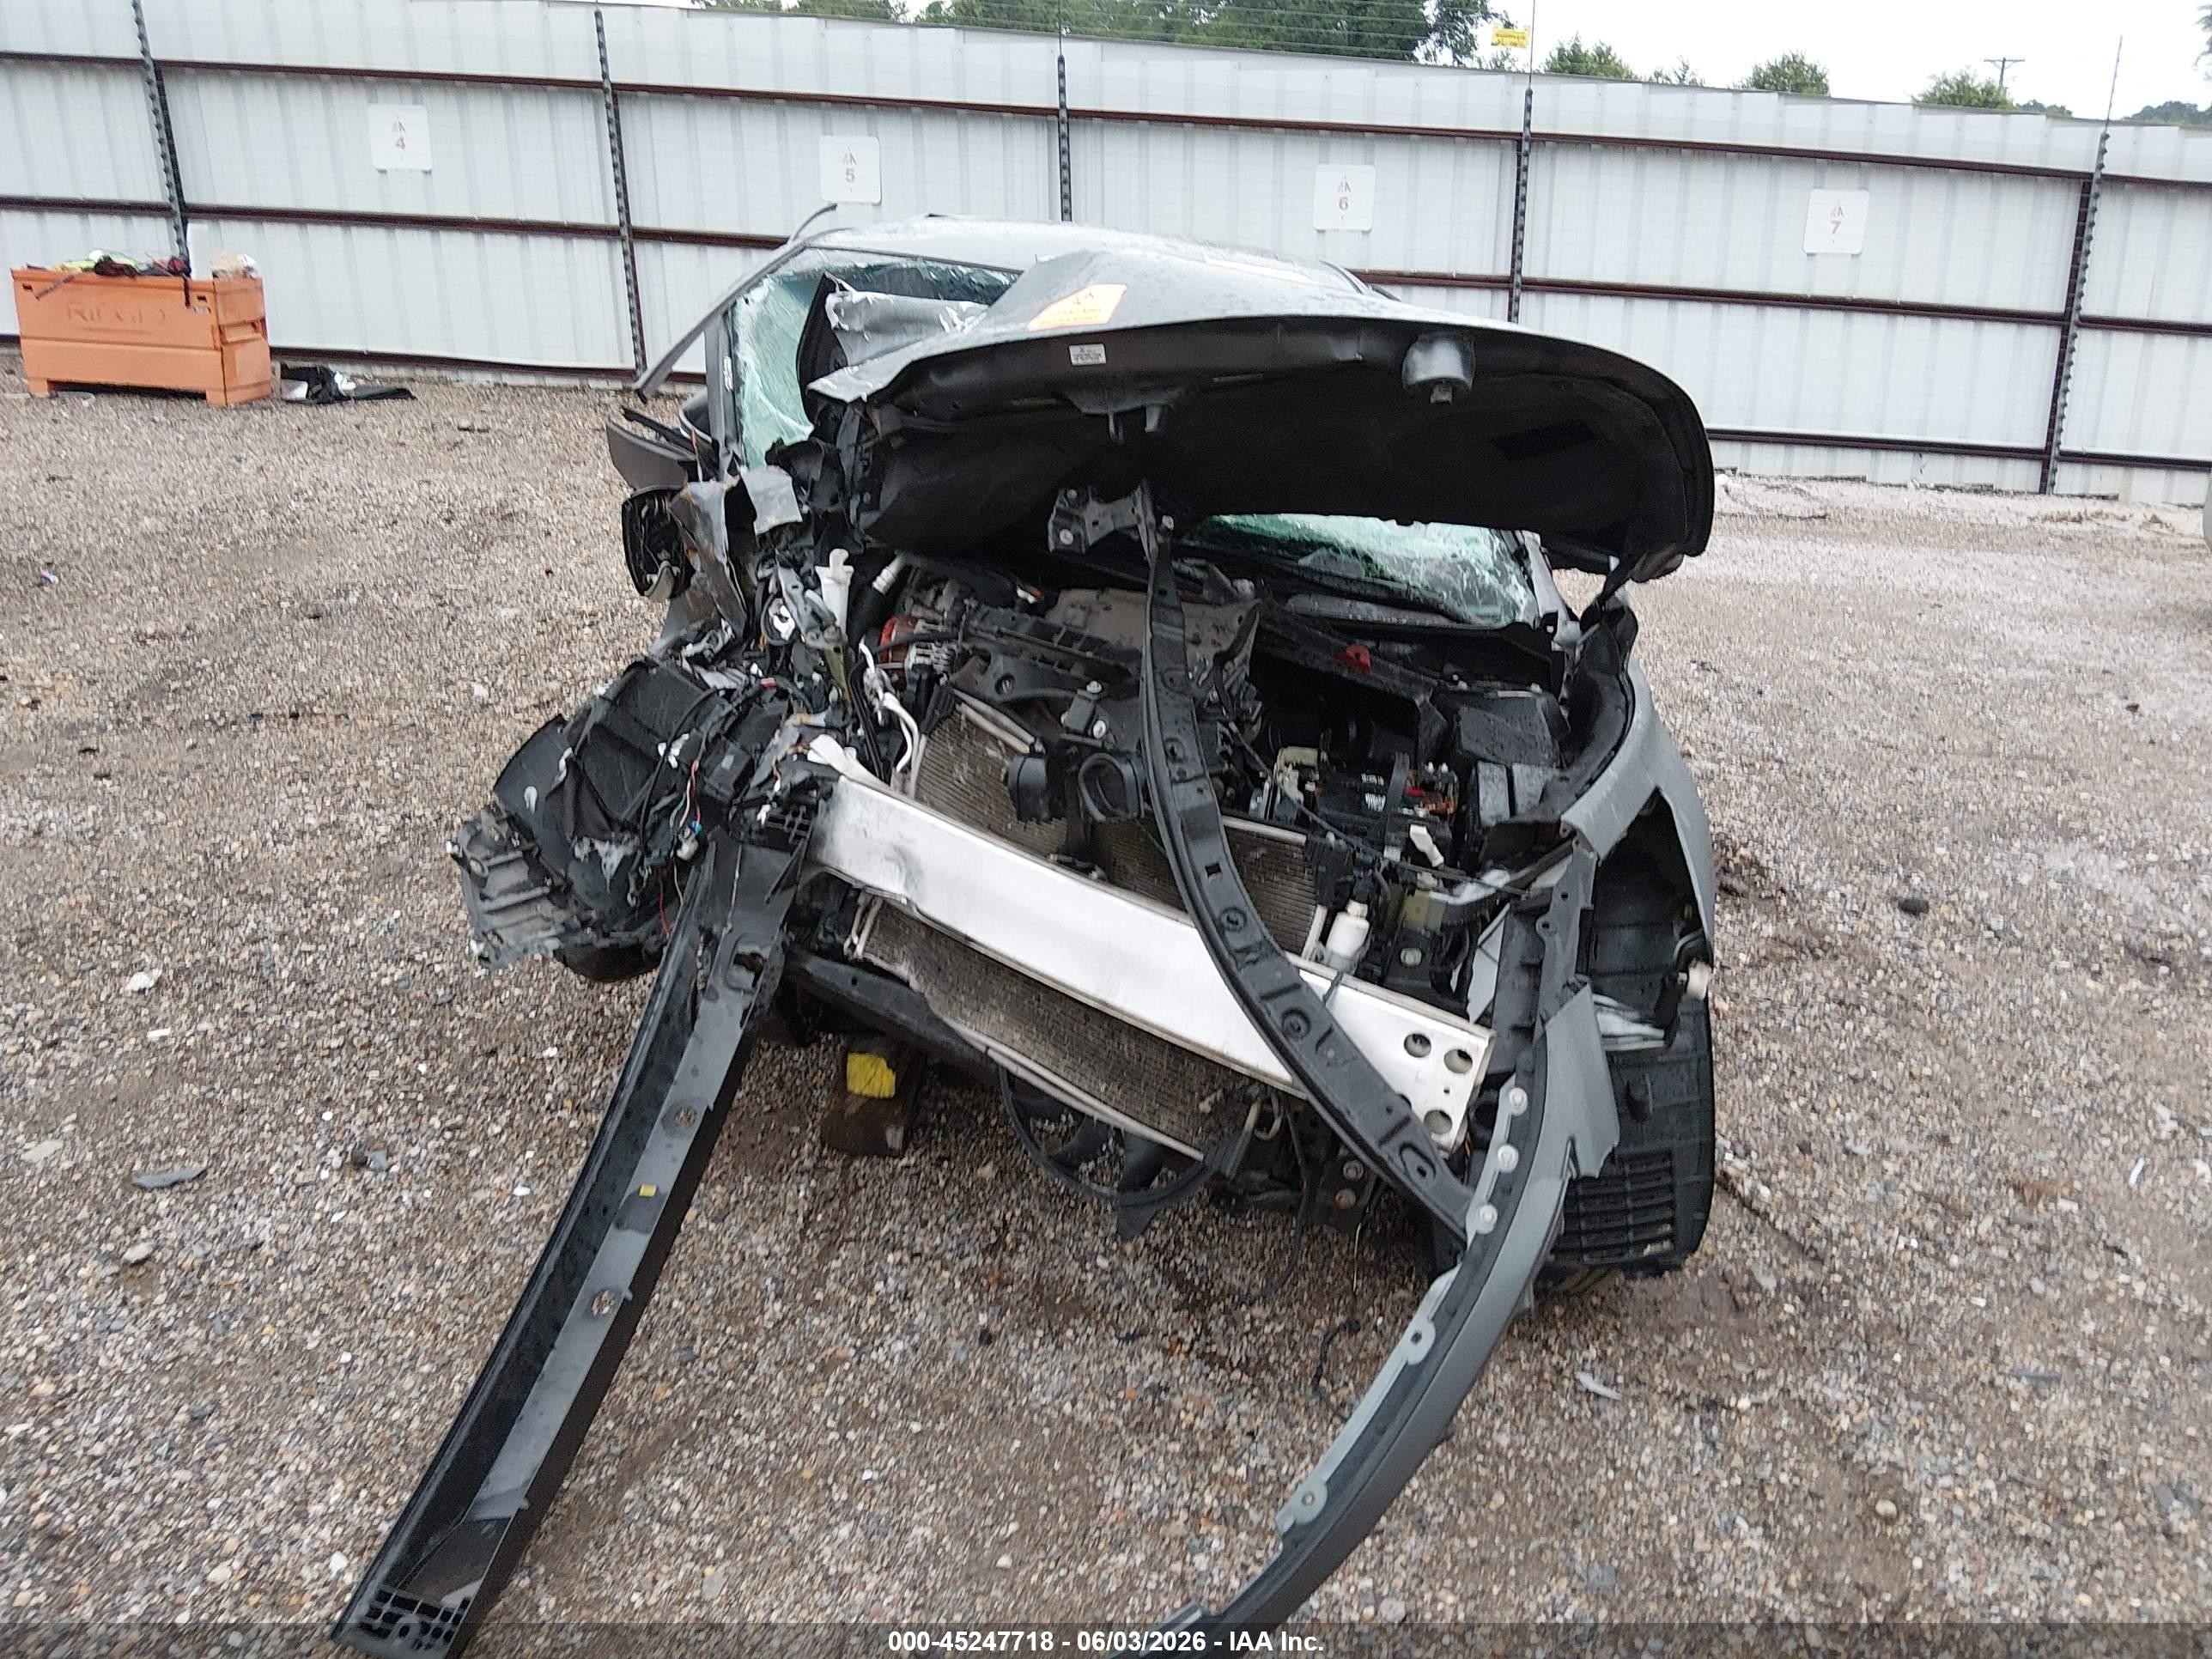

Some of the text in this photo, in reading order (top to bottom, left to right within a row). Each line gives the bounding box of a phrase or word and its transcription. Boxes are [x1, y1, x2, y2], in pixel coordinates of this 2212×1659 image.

[395, 136, 407, 150] 4
[845, 168, 856, 183] 5
[1338, 196, 1349, 210] 6
[1830, 220, 1842, 234] 7
